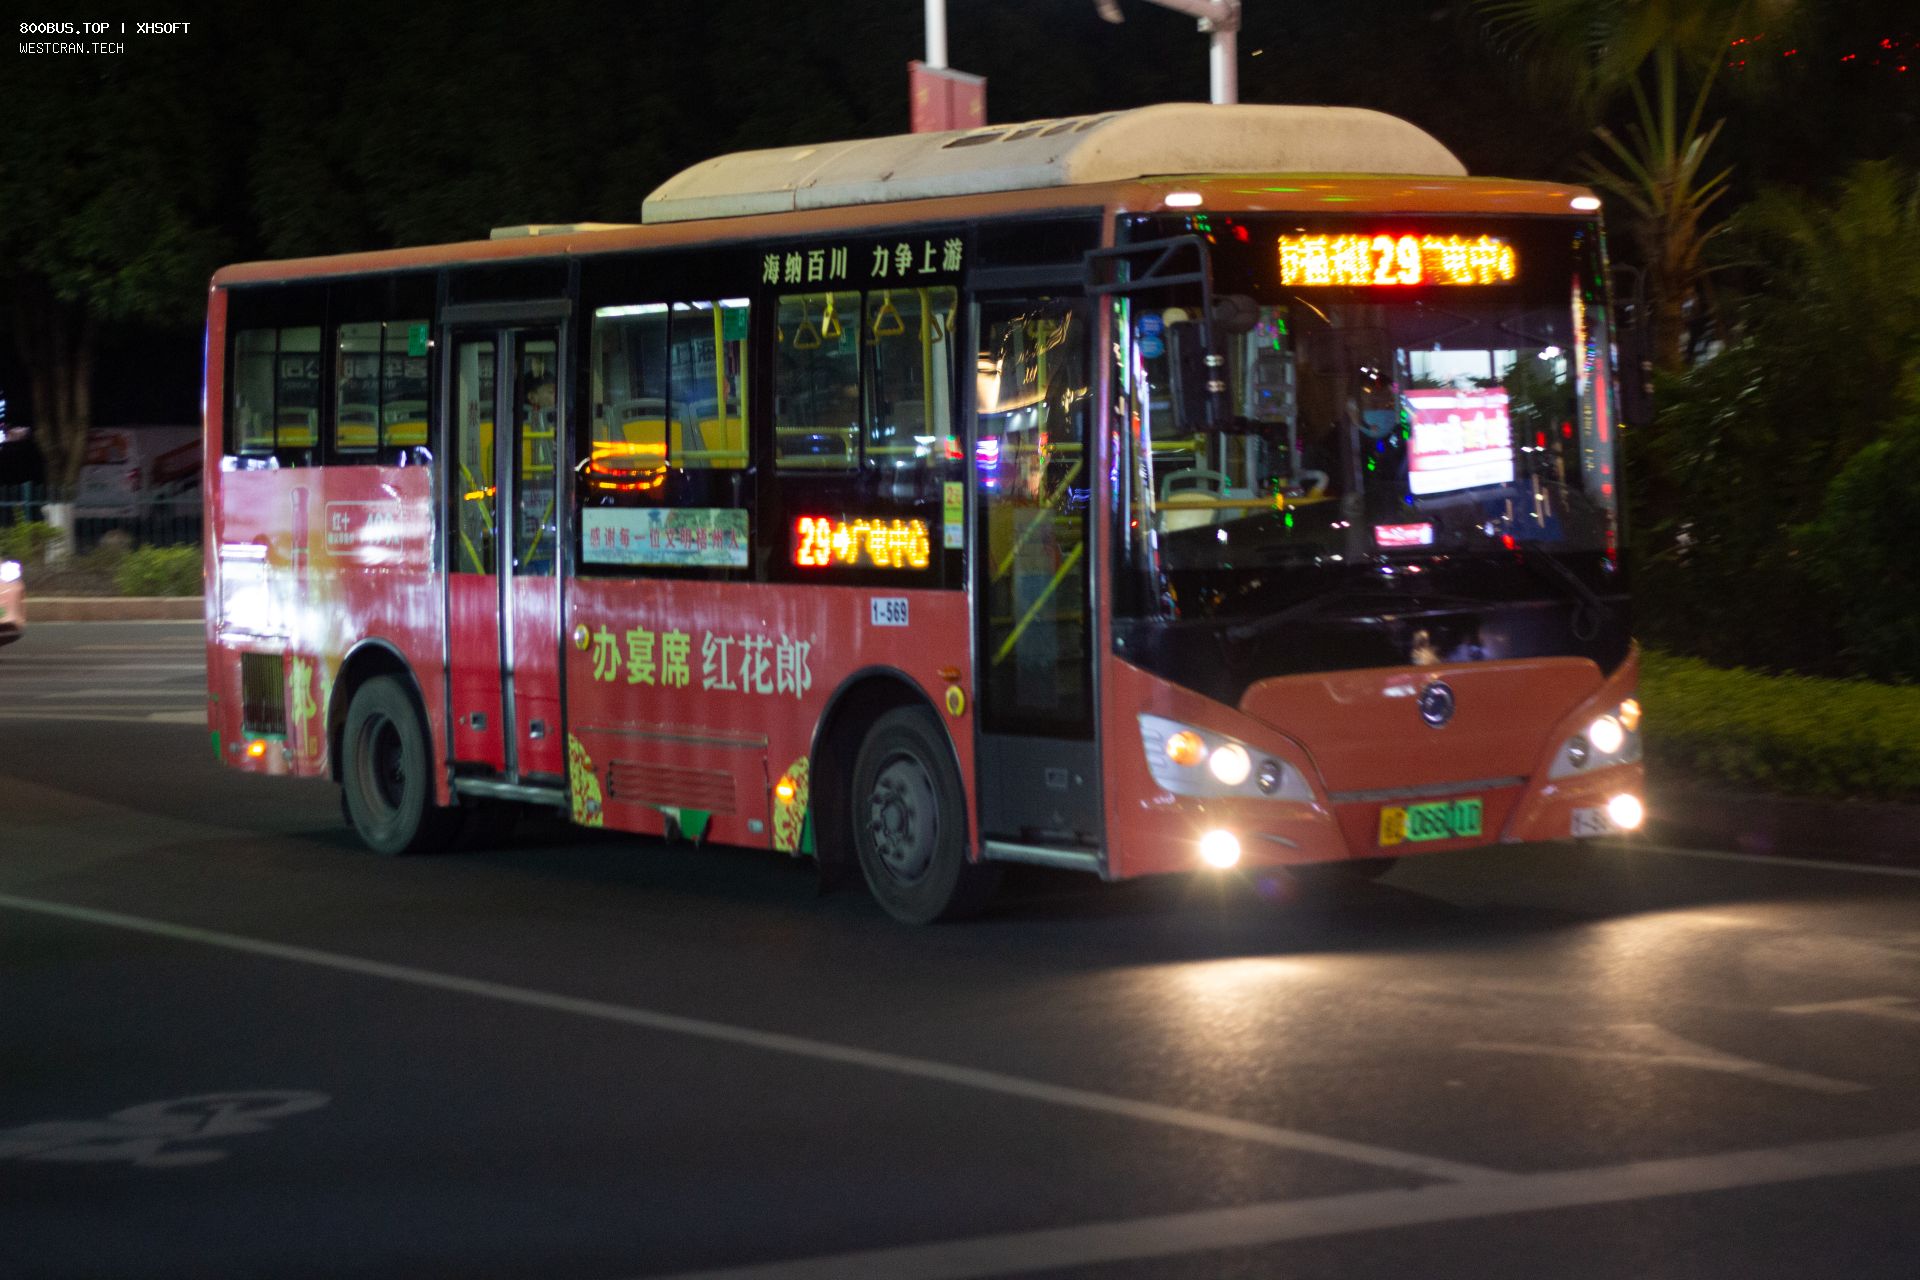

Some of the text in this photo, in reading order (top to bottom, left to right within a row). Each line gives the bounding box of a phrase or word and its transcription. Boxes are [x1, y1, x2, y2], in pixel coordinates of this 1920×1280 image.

[762, 238, 963, 285] 海纳百川 力争上游
[1371, 234, 1422, 286] 29
[590, 526, 740, 552] 感谢每一位文明梧州人
[797, 517, 831, 566] 29
[873, 602, 908, 622] 1-569
[592, 624, 813, 700] 办宴席 红花郎
